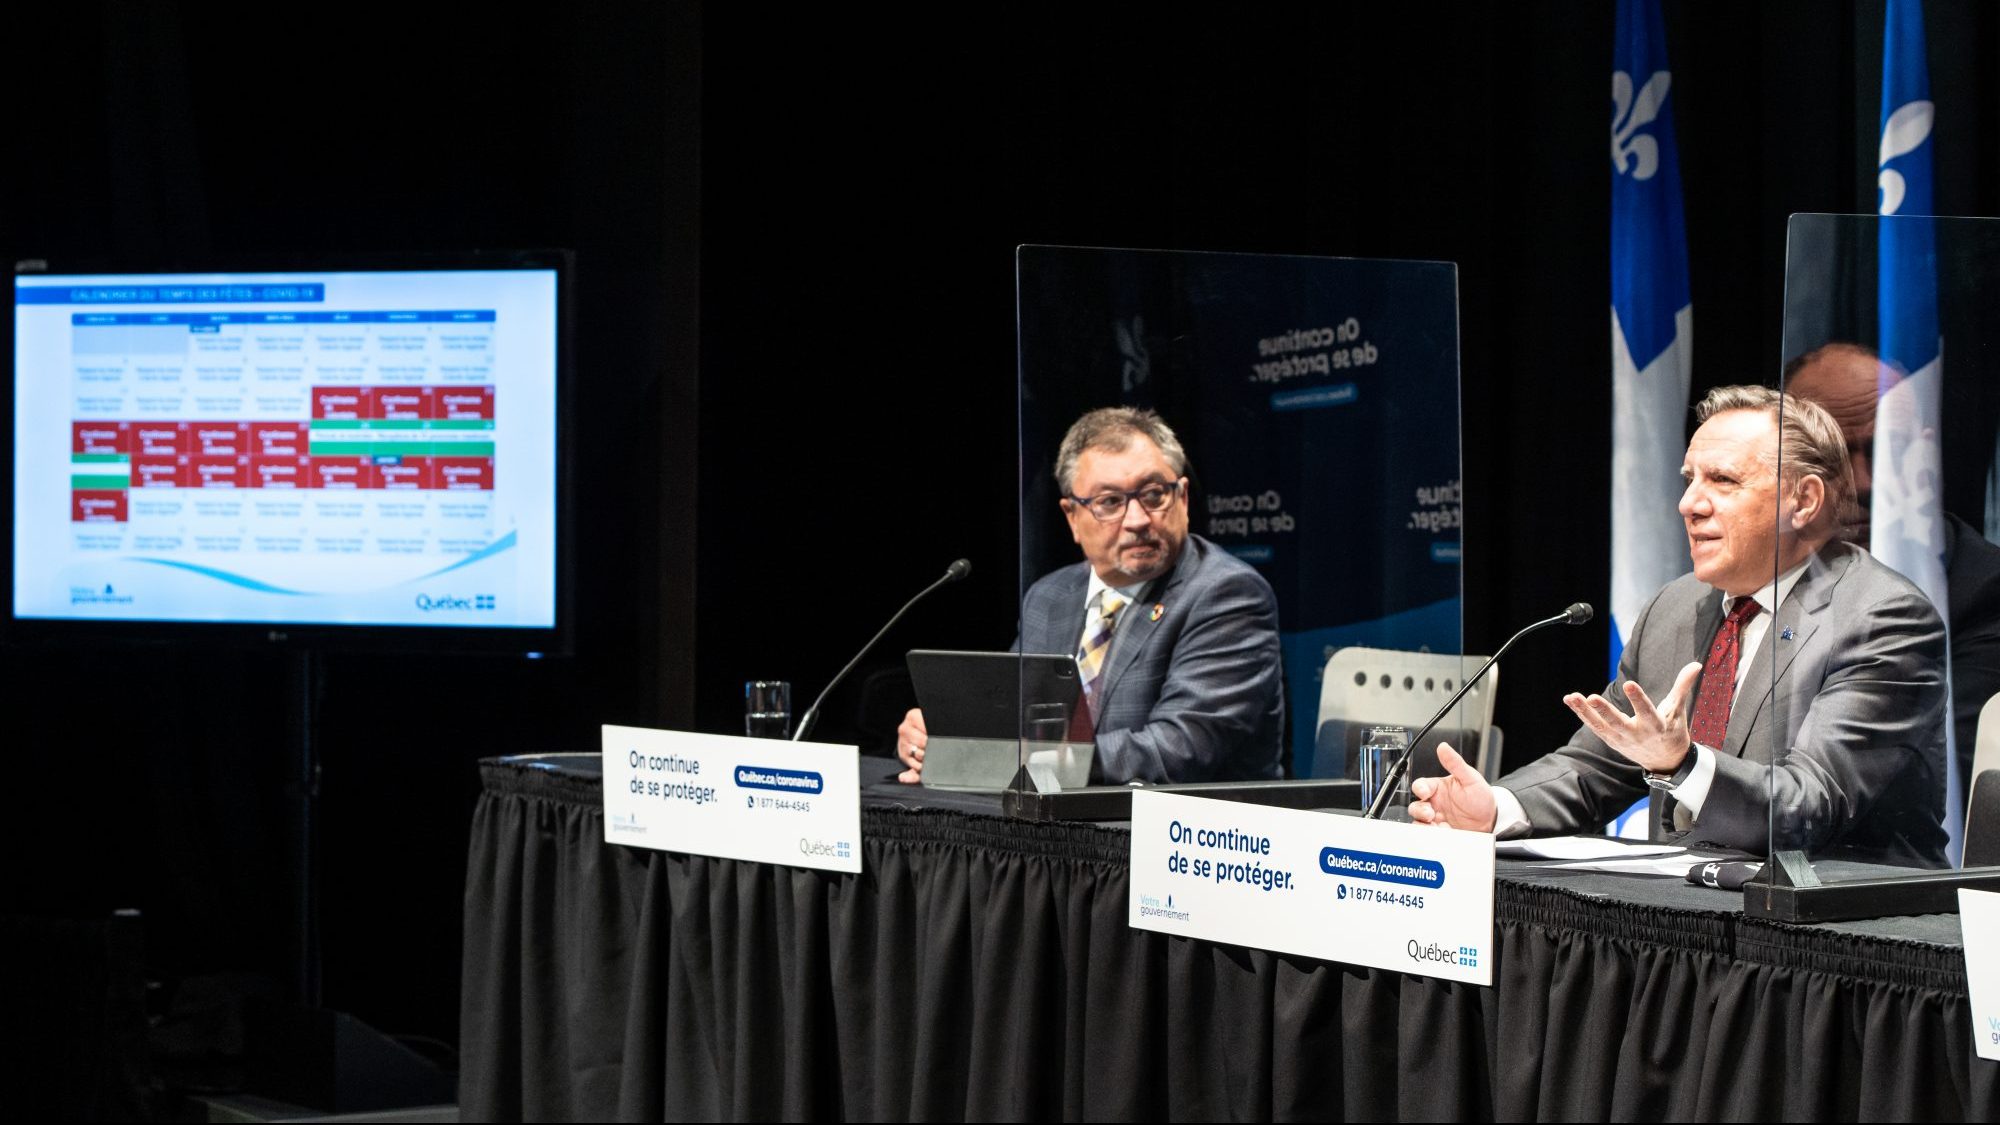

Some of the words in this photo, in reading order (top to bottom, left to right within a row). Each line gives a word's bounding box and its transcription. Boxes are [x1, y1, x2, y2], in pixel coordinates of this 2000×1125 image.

[416, 593, 471, 611] Québec
[630, 750, 646, 769] On
[649, 754, 700, 775] continue
[630, 776, 644, 794] de
[648, 781, 660, 796] se
[663, 780, 718, 805] protéger.
[738, 770, 819, 789] Québec.ca/coronavirus
[775, 799, 810, 812] 644-4545
[800, 838, 836, 857] Québec
[1169, 820, 1192, 845] On
[1197, 826, 1270, 856] continue
[1168, 851, 1188, 876] de
[1193, 859, 1211, 878] se
[1216, 862, 1294, 892] protéger.
[1327, 853, 1438, 881] Québec.ca/coronavirus
[1140, 893, 1160, 907] Votre
[1356, 887, 1373, 901] 877
[1376, 890, 1424, 909] 644-4545
[1140, 906, 1190, 921] gouvernement
[1407, 939, 1457, 964] Québec
